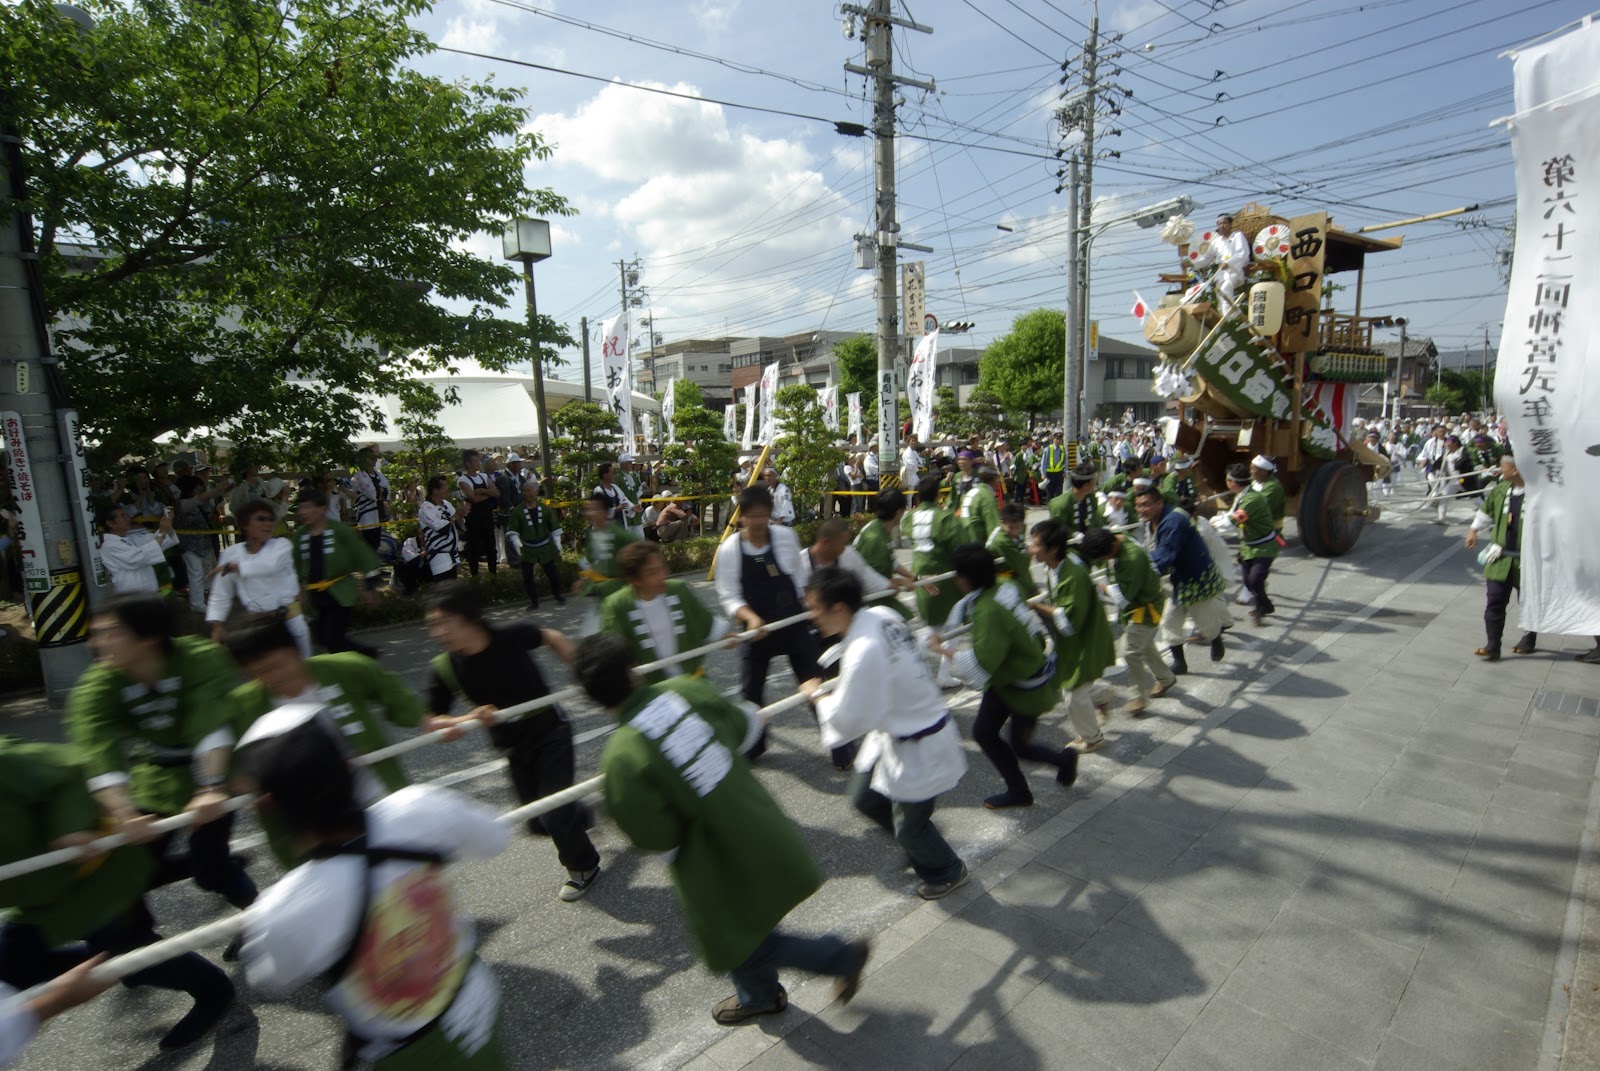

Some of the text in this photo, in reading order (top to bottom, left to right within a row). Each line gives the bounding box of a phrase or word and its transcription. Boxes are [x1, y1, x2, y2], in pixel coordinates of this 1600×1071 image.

[1286, 226, 1323, 338] 西口町
[925, 320, 935, 331] 40
[6, 417, 33, 502] お好み焼き・焼そば
